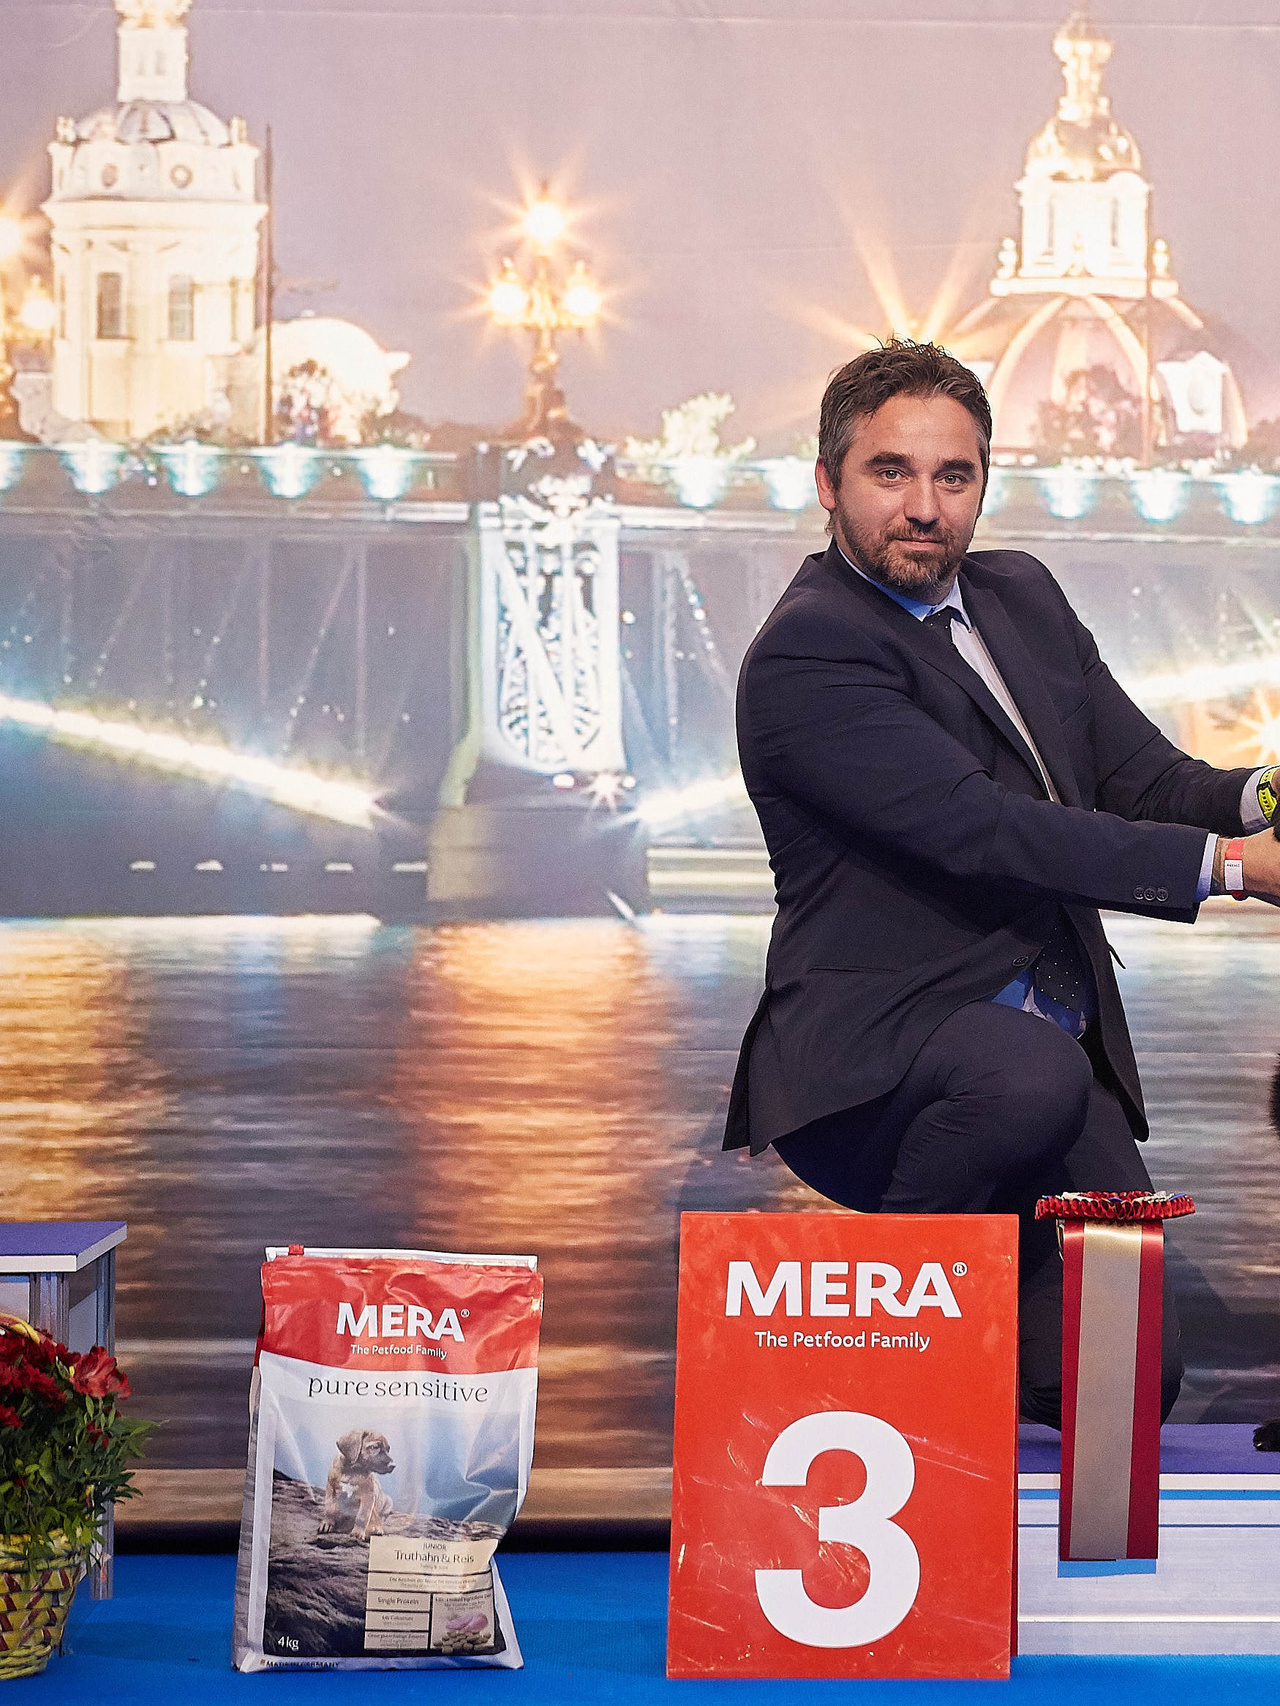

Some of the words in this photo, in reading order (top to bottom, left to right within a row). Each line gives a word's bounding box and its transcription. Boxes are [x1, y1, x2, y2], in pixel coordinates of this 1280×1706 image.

[351, 1344, 370, 1355] The
[371, 1344, 414, 1355] Petfood
[415, 1345, 448, 1360] Family
[754, 1331, 788, 1348] The
[793, 1331, 866, 1348] Petfood
[870, 1331, 931, 1353] Family
[308, 1377, 369, 1398] pure
[374, 1379, 488, 1403] sensitive
[754, 1410, 921, 1648] 3
[453, 1554, 475, 1564] Reis
